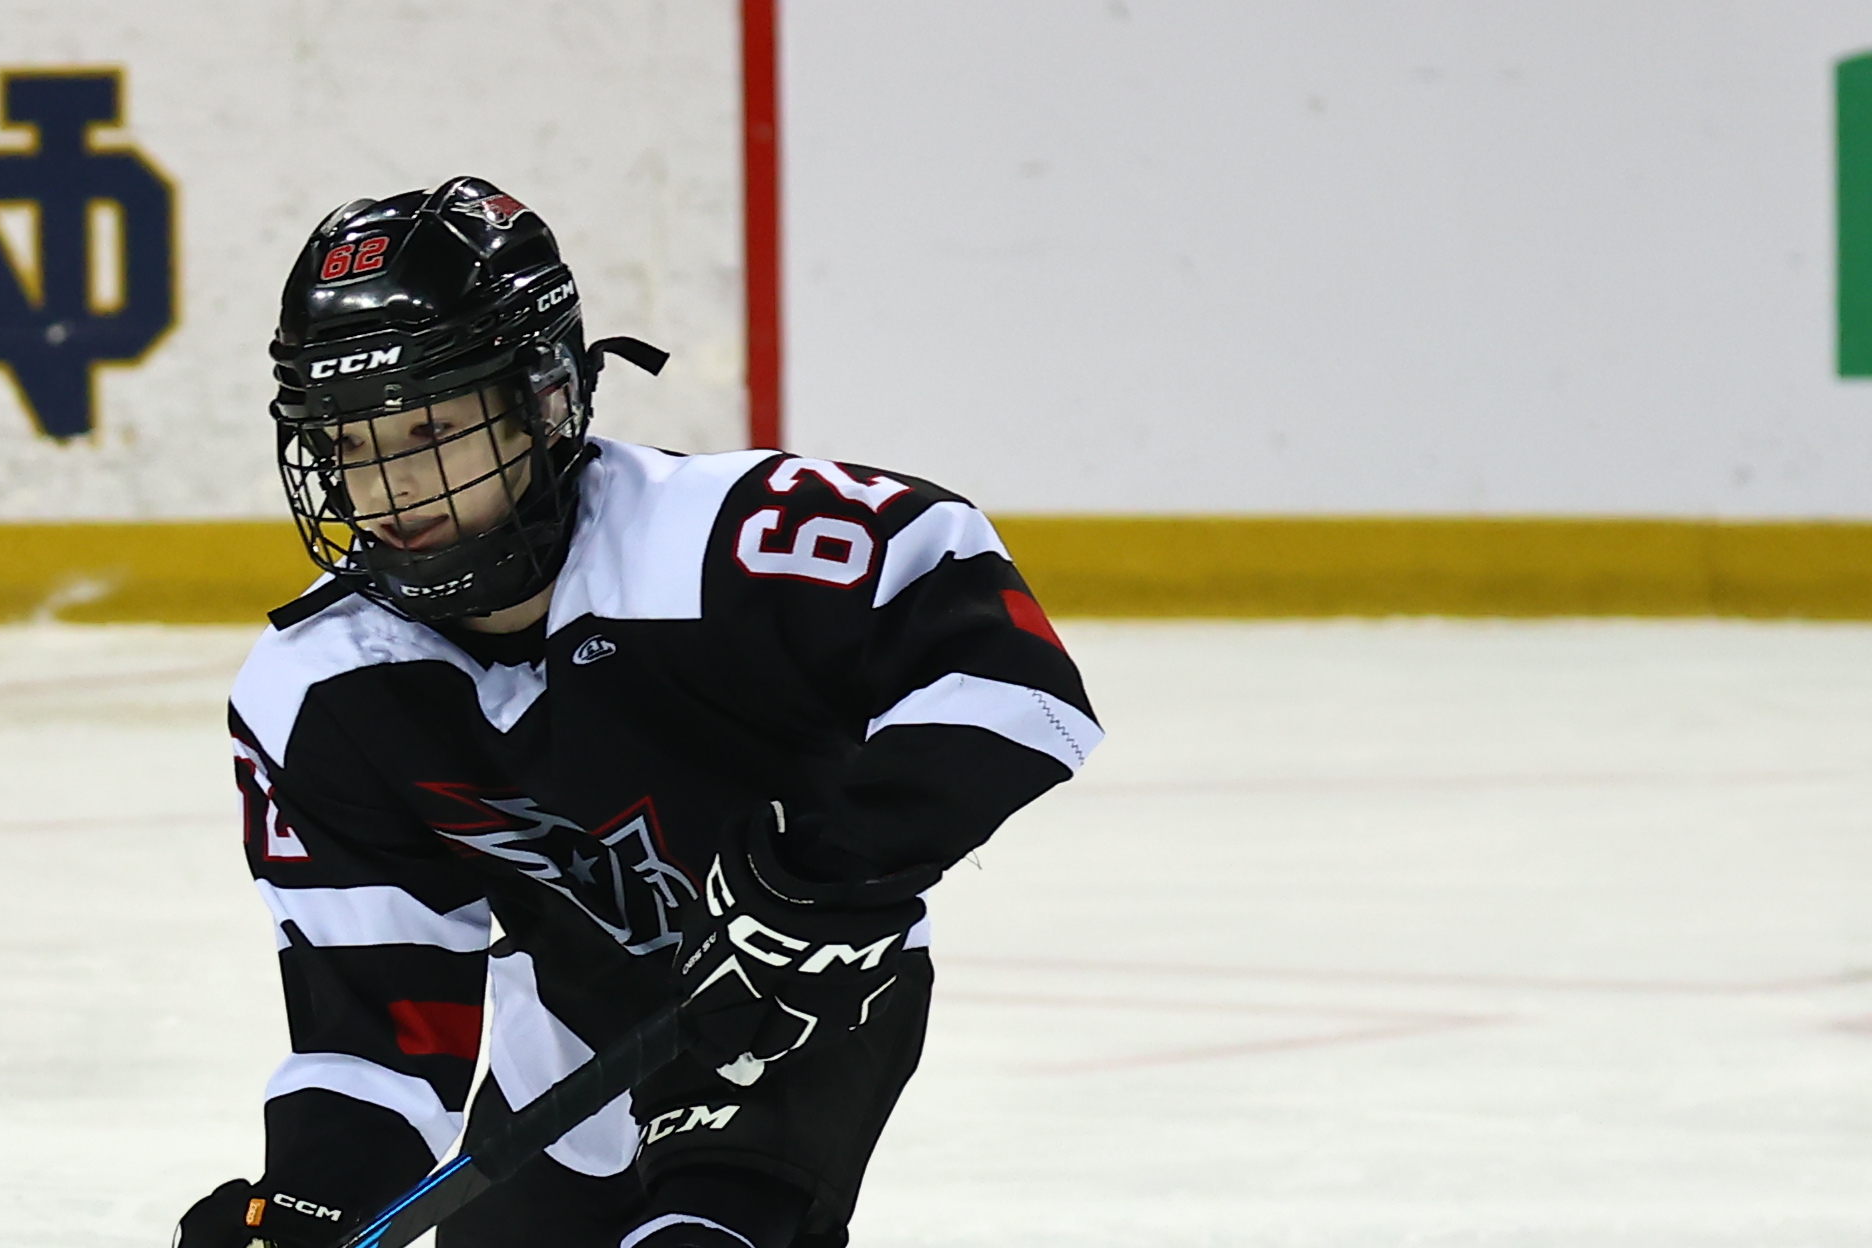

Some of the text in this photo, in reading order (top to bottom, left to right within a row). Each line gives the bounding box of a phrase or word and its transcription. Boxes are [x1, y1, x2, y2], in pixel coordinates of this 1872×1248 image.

[321, 236, 390, 281] 62
[535, 279, 575, 313] CCM
[310, 345, 403, 380] CCM
[733, 456, 915, 590] 62
[704, 852, 902, 974] CCM
[272, 1193, 342, 1222] CCM
